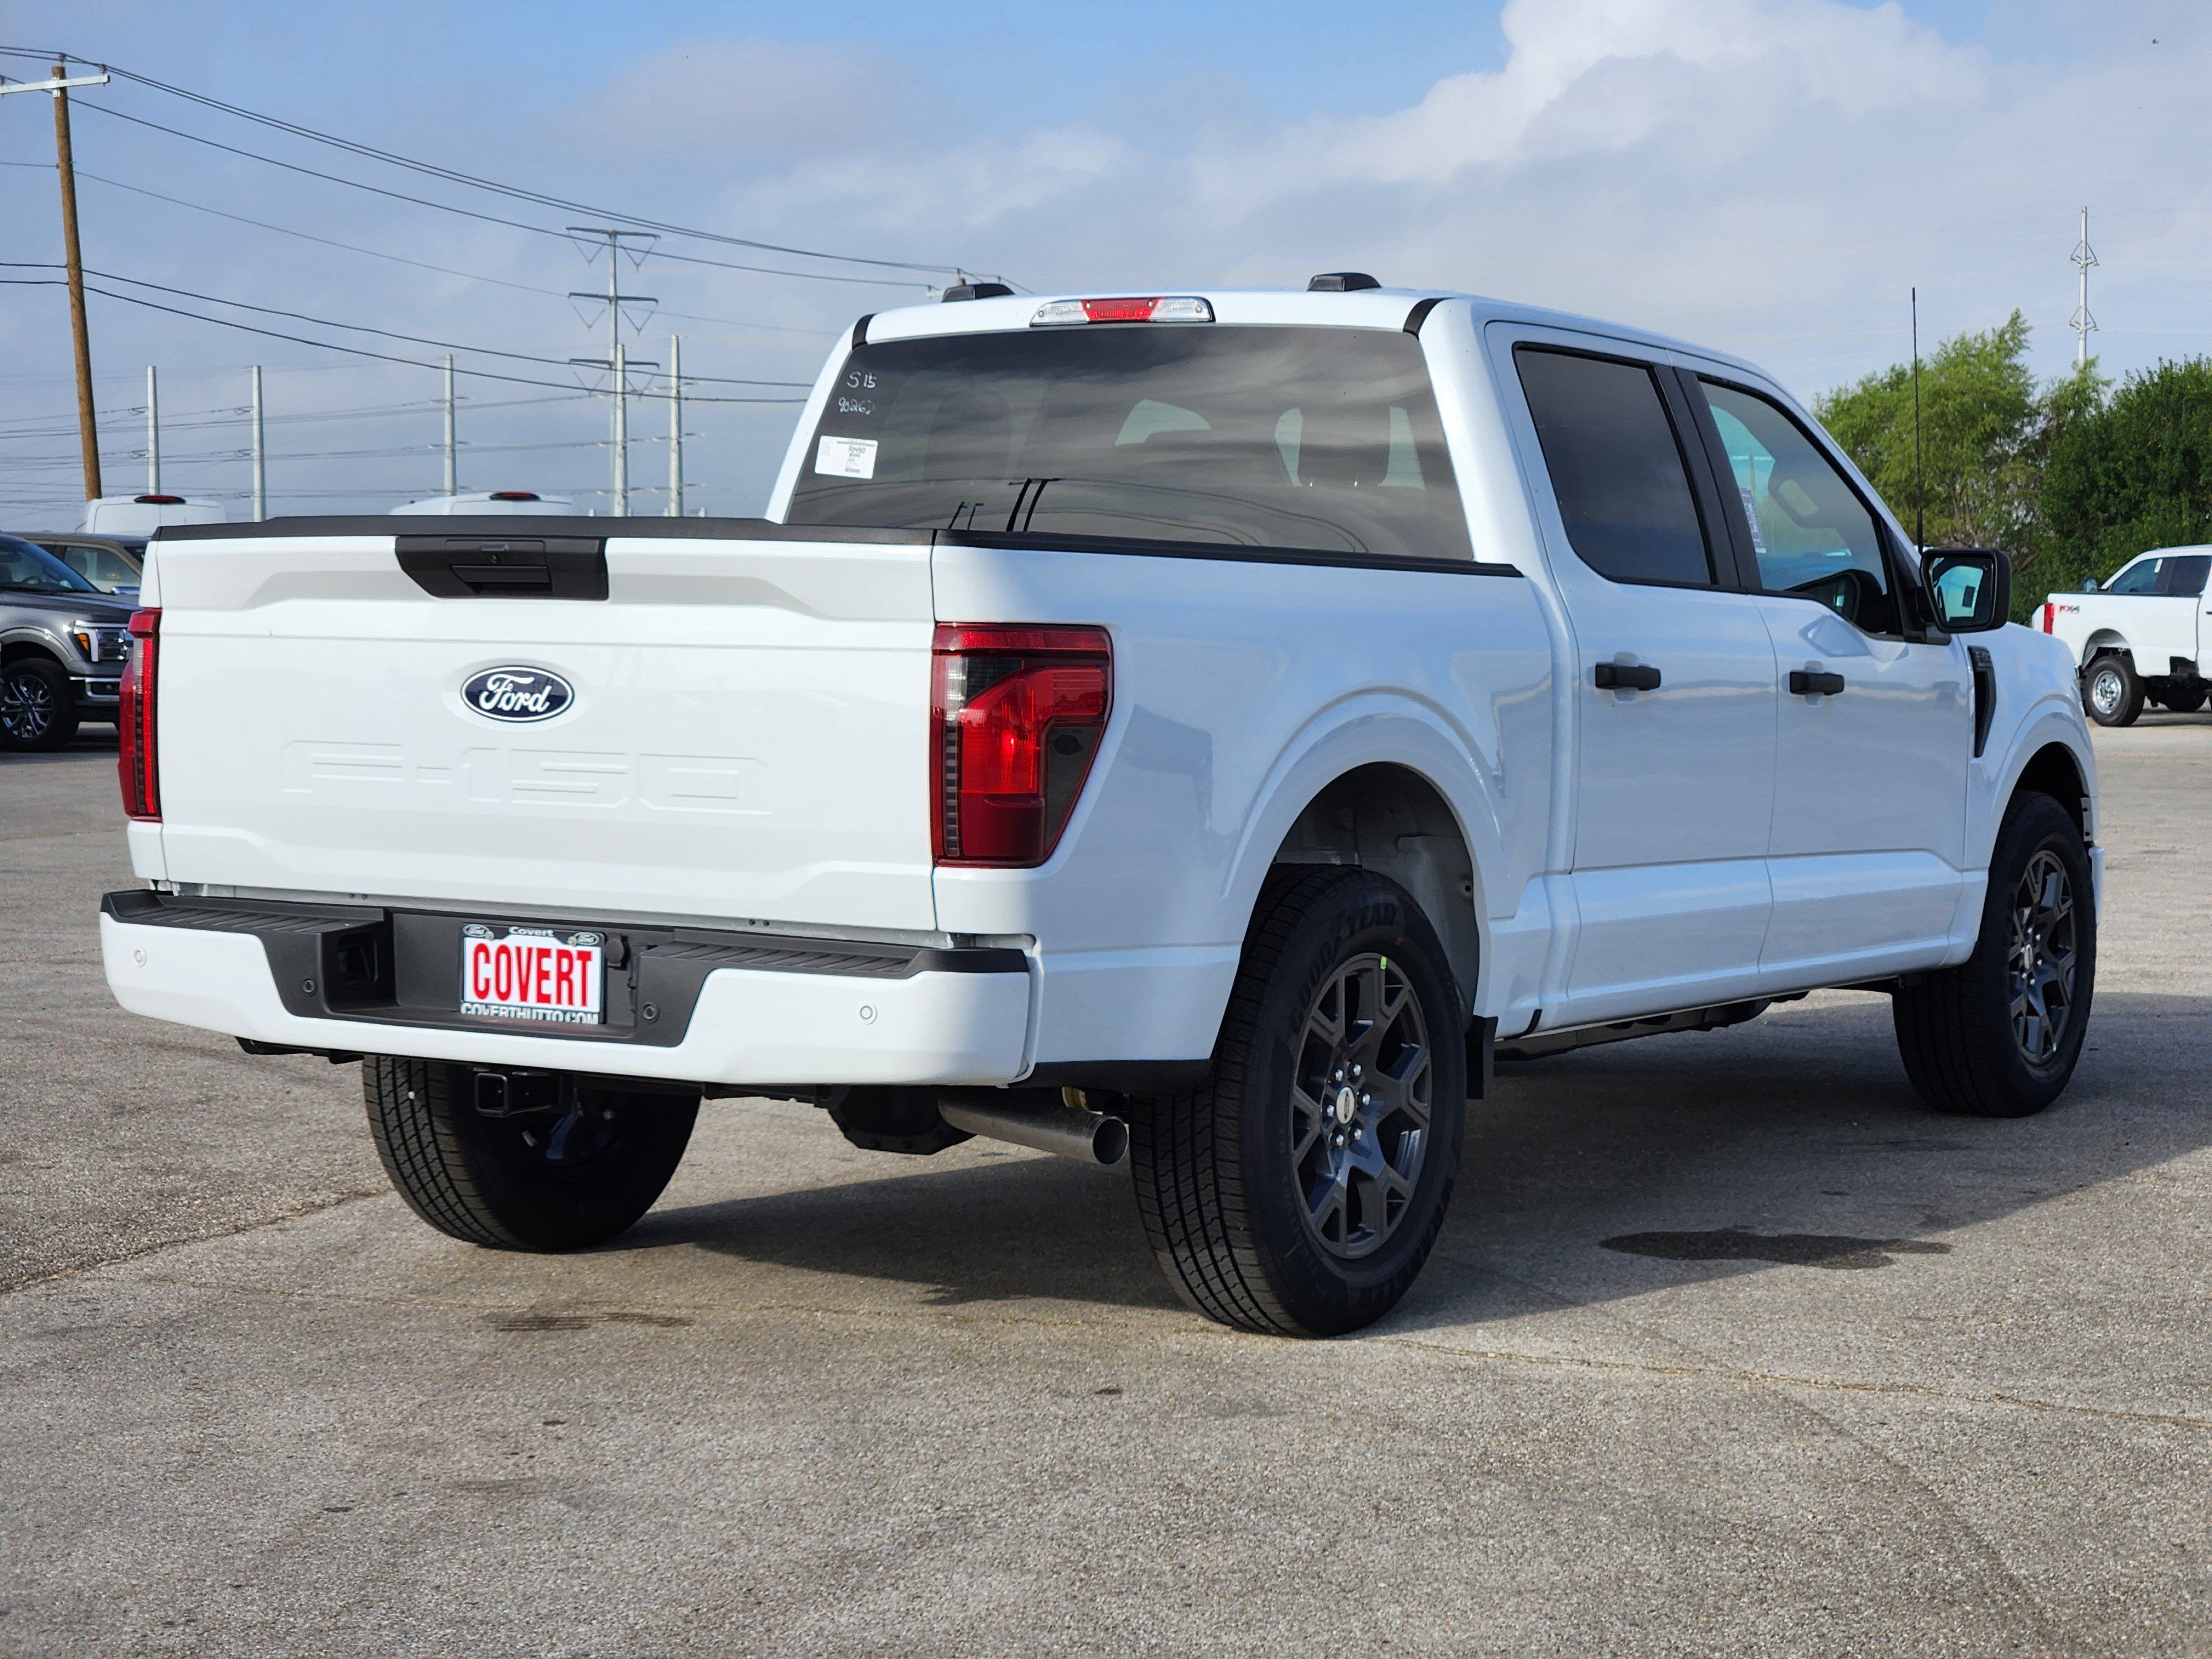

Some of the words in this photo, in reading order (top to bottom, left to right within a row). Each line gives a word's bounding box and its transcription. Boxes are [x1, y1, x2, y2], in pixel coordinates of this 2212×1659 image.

[479, 674, 552, 712] Ford
[281, 740, 771, 815] F-150
[509, 926, 554, 937] Covert
[473, 943, 593, 1007] COVERT
[461, 1003, 599, 1025] COVERTHUTTOCOM
